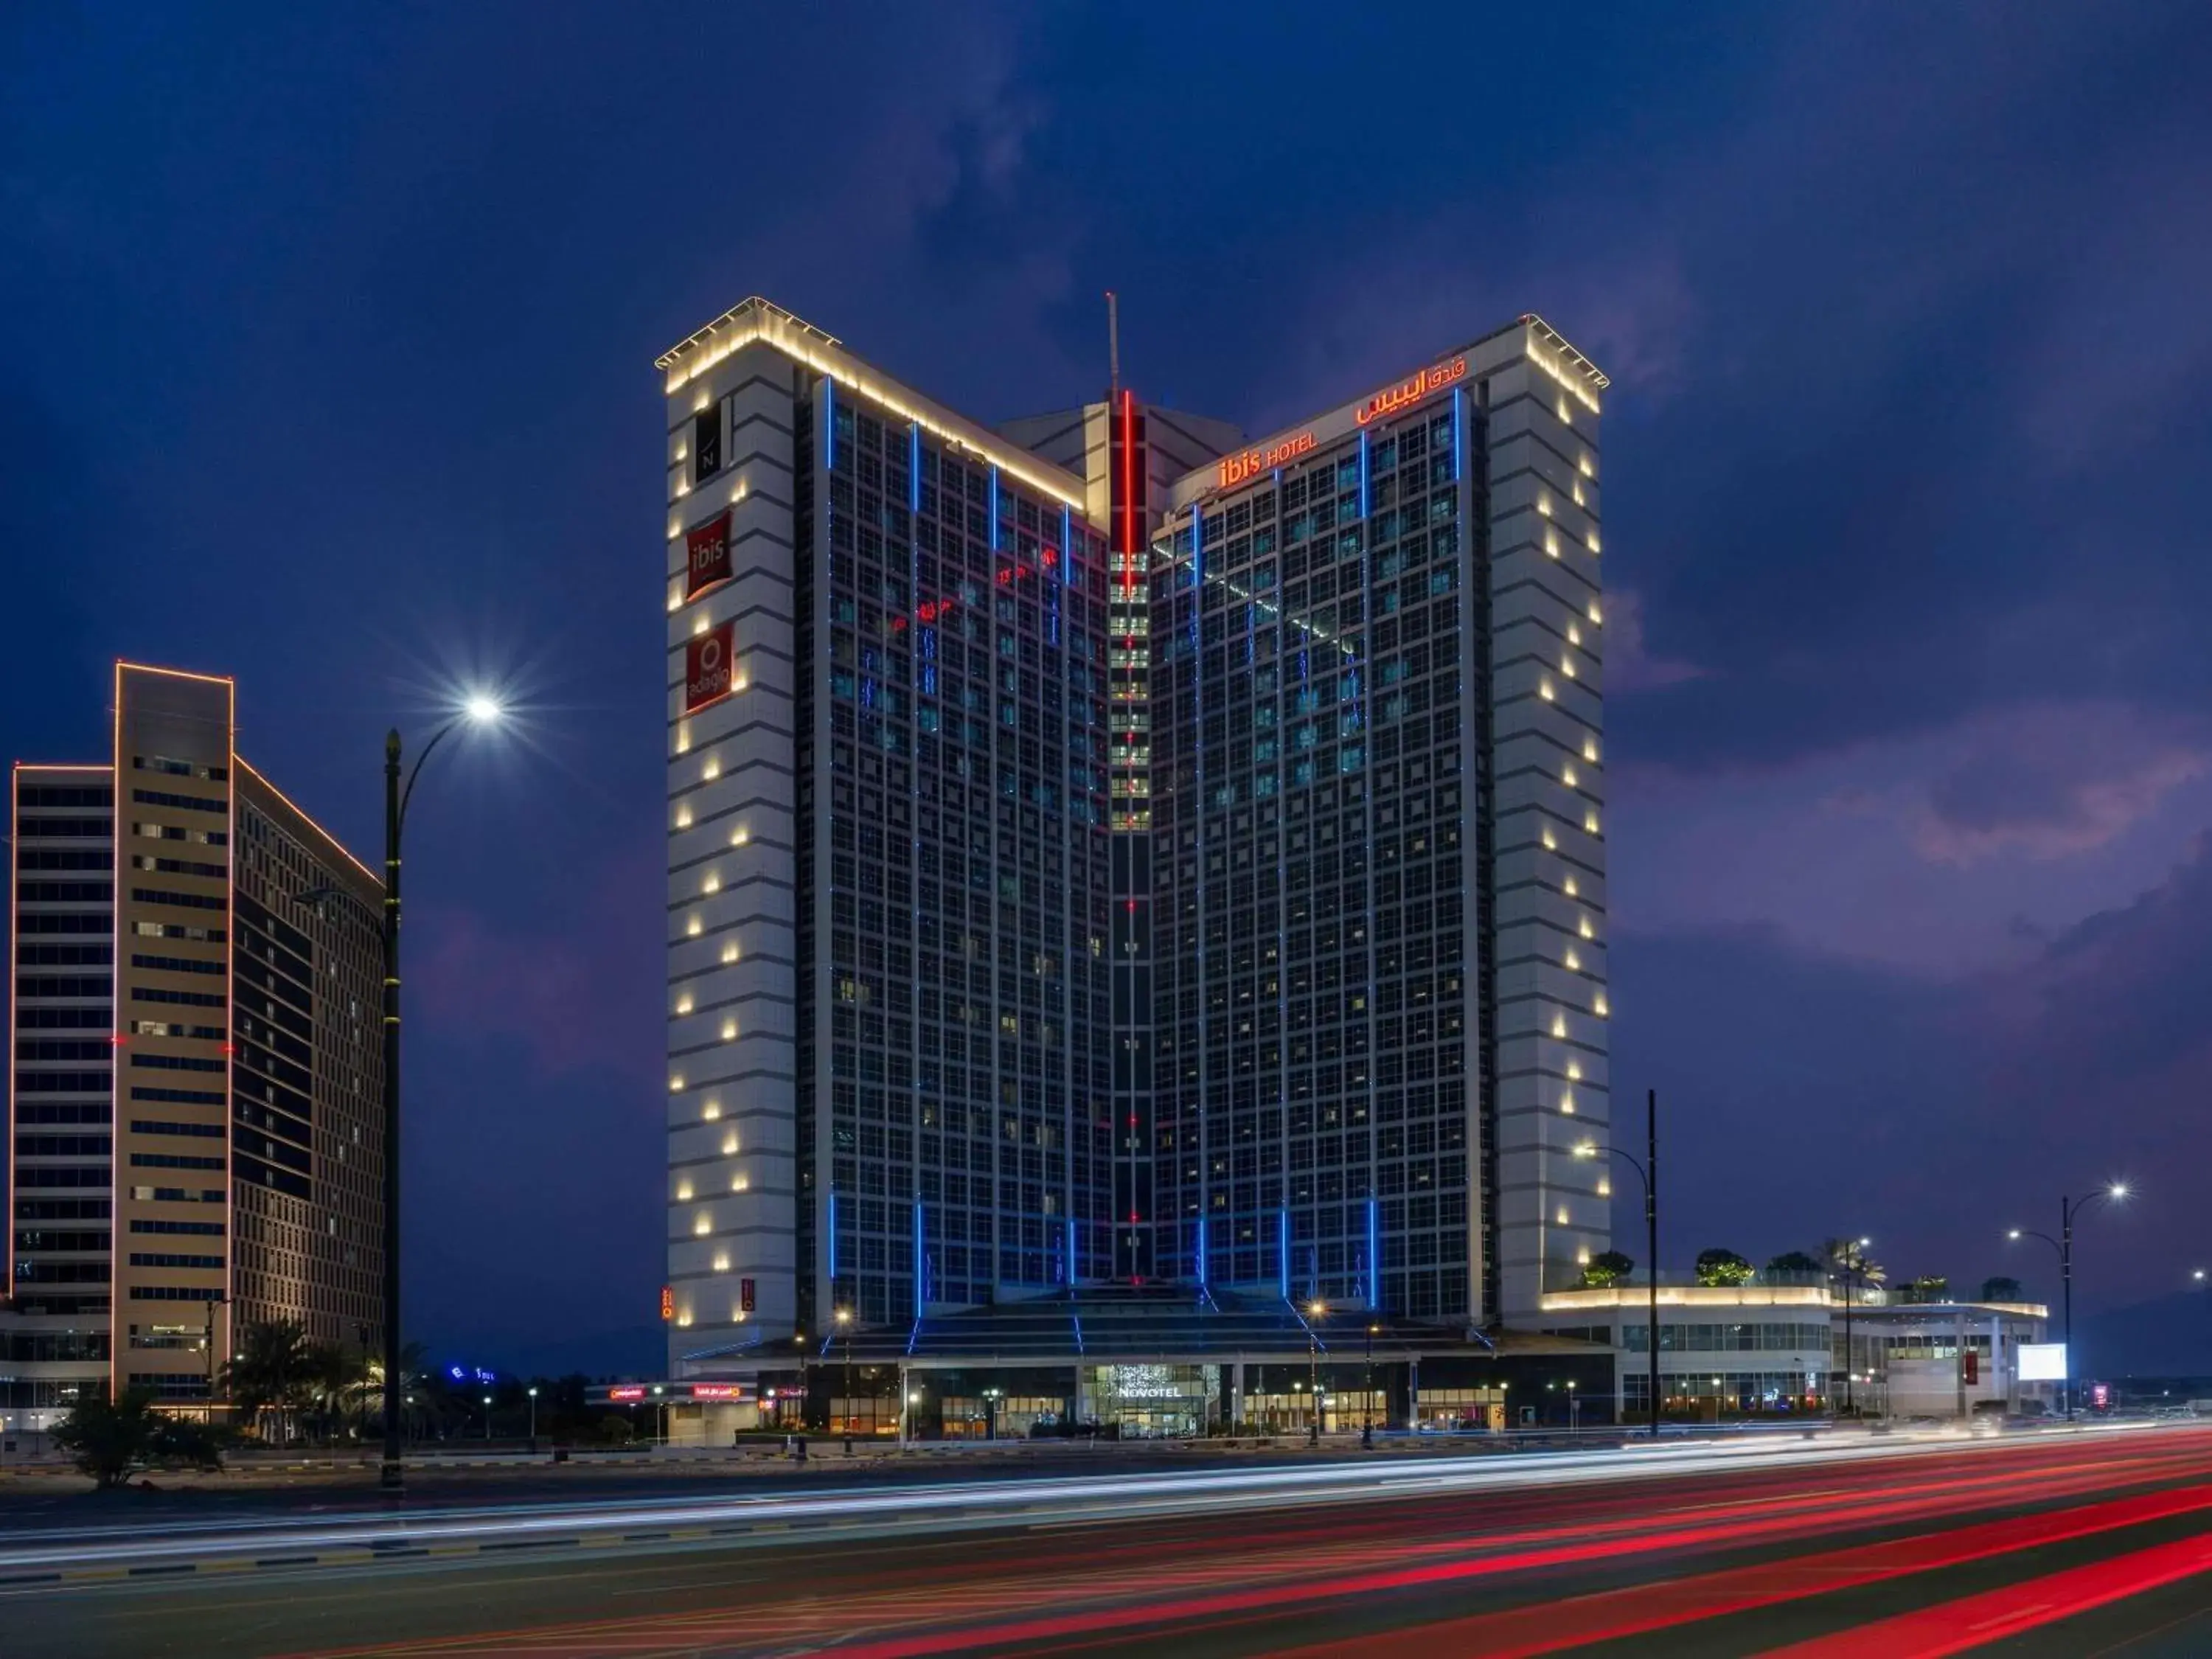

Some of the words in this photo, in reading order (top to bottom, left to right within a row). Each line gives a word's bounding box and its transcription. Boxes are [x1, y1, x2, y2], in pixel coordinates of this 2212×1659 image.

[1427, 357, 1464, 389] فندق
[703, 451, 713, 470] N
[1221, 451, 1261, 487] ibis
[1267, 432, 1317, 466] HOTEL
[692, 538, 724, 572] ibis
[1119, 1387, 1182, 1398] NOVOTEL
